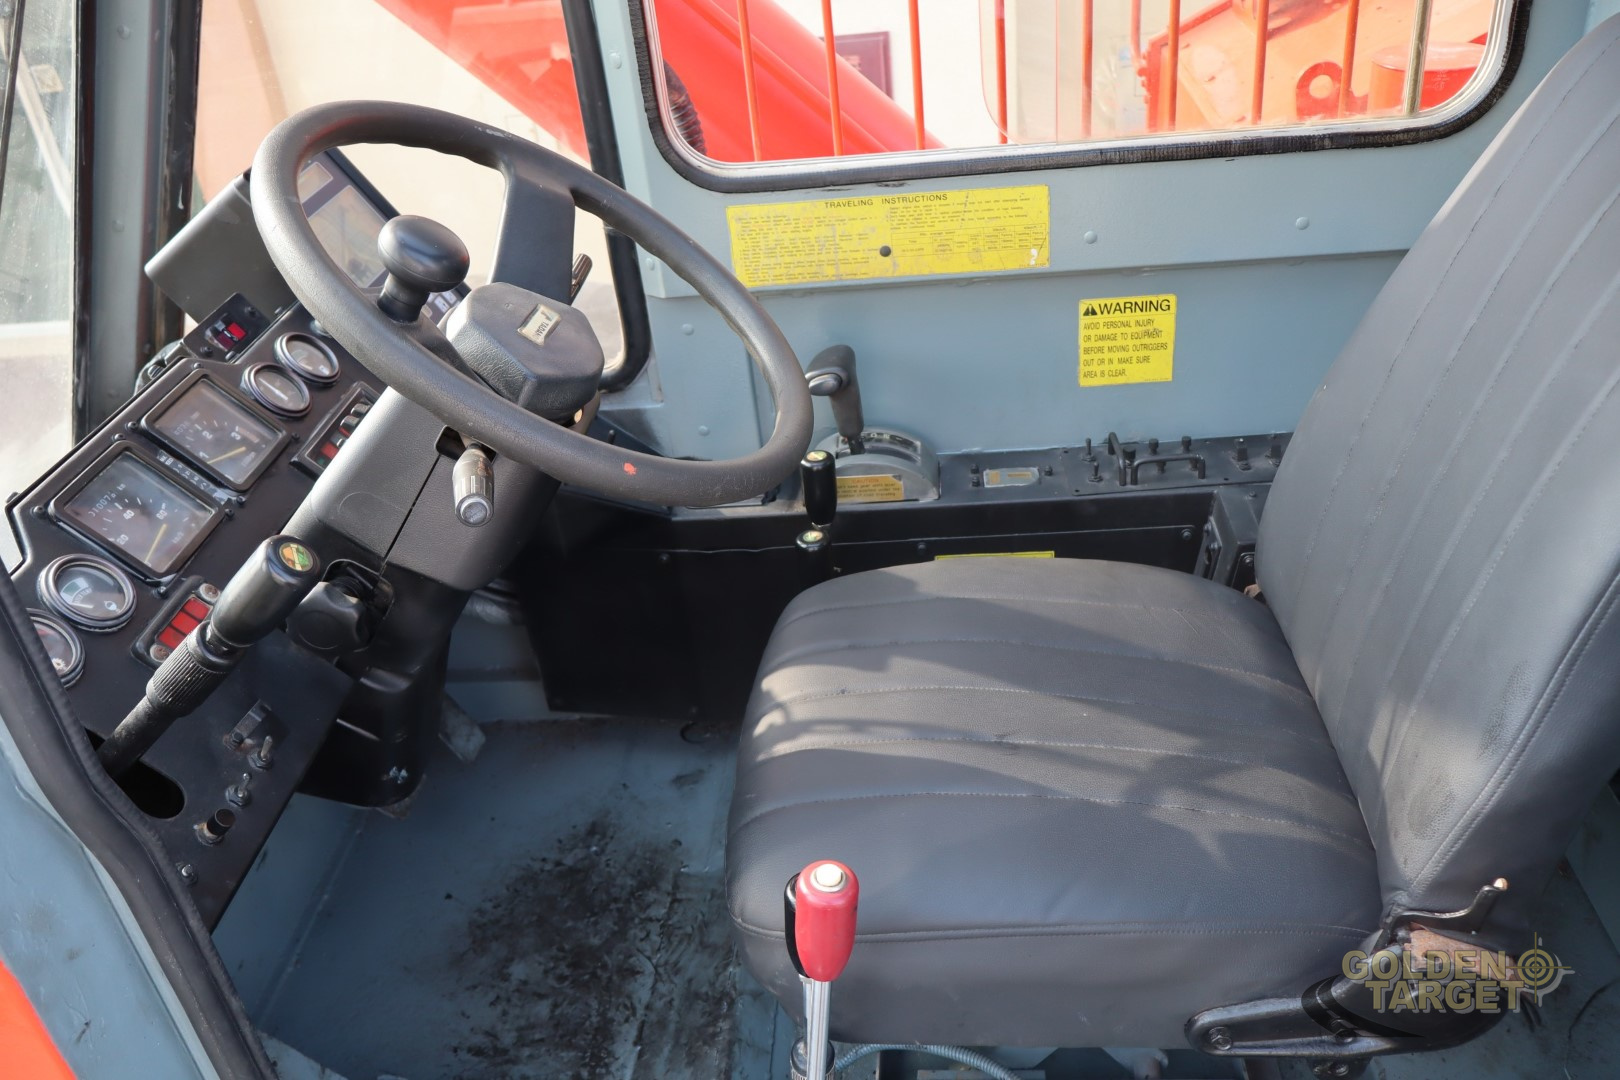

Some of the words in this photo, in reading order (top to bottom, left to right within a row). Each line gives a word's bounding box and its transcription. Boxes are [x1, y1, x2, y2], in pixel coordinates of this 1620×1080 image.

[824, 198, 874, 209] TRAVELING
[881, 193, 948, 205] INSTRUCTIONS
[1098, 299, 1171, 315] WARNING
[1083, 321, 1100, 330] AVOID
[1102, 320, 1132, 329] PERSONAL
[1135, 318, 1155, 327] INJURY
[1083, 334, 1092, 343] OR
[1094, 333, 1118, 342] DAMAGE
[1120, 332, 1128, 340] TO
[1131, 330, 1163, 340] EQUIPMENT
[1083, 345, 1105, 355] BEFORE
[1107, 344, 1130, 353] MOVING
[1132, 342, 1168, 352] OUTRIGGERS
[1083, 358, 1094, 367] OUT
[1097, 358, 1105, 366] OR
[1117, 356, 1133, 365] MAKE
[1135, 355, 1151, 364] SURE
[1083, 370, 1098, 378] AREA
[1100, 369, 1106, 377] IS
[123, 509, 135, 520] 40
[116, 534, 129, 545] 20
